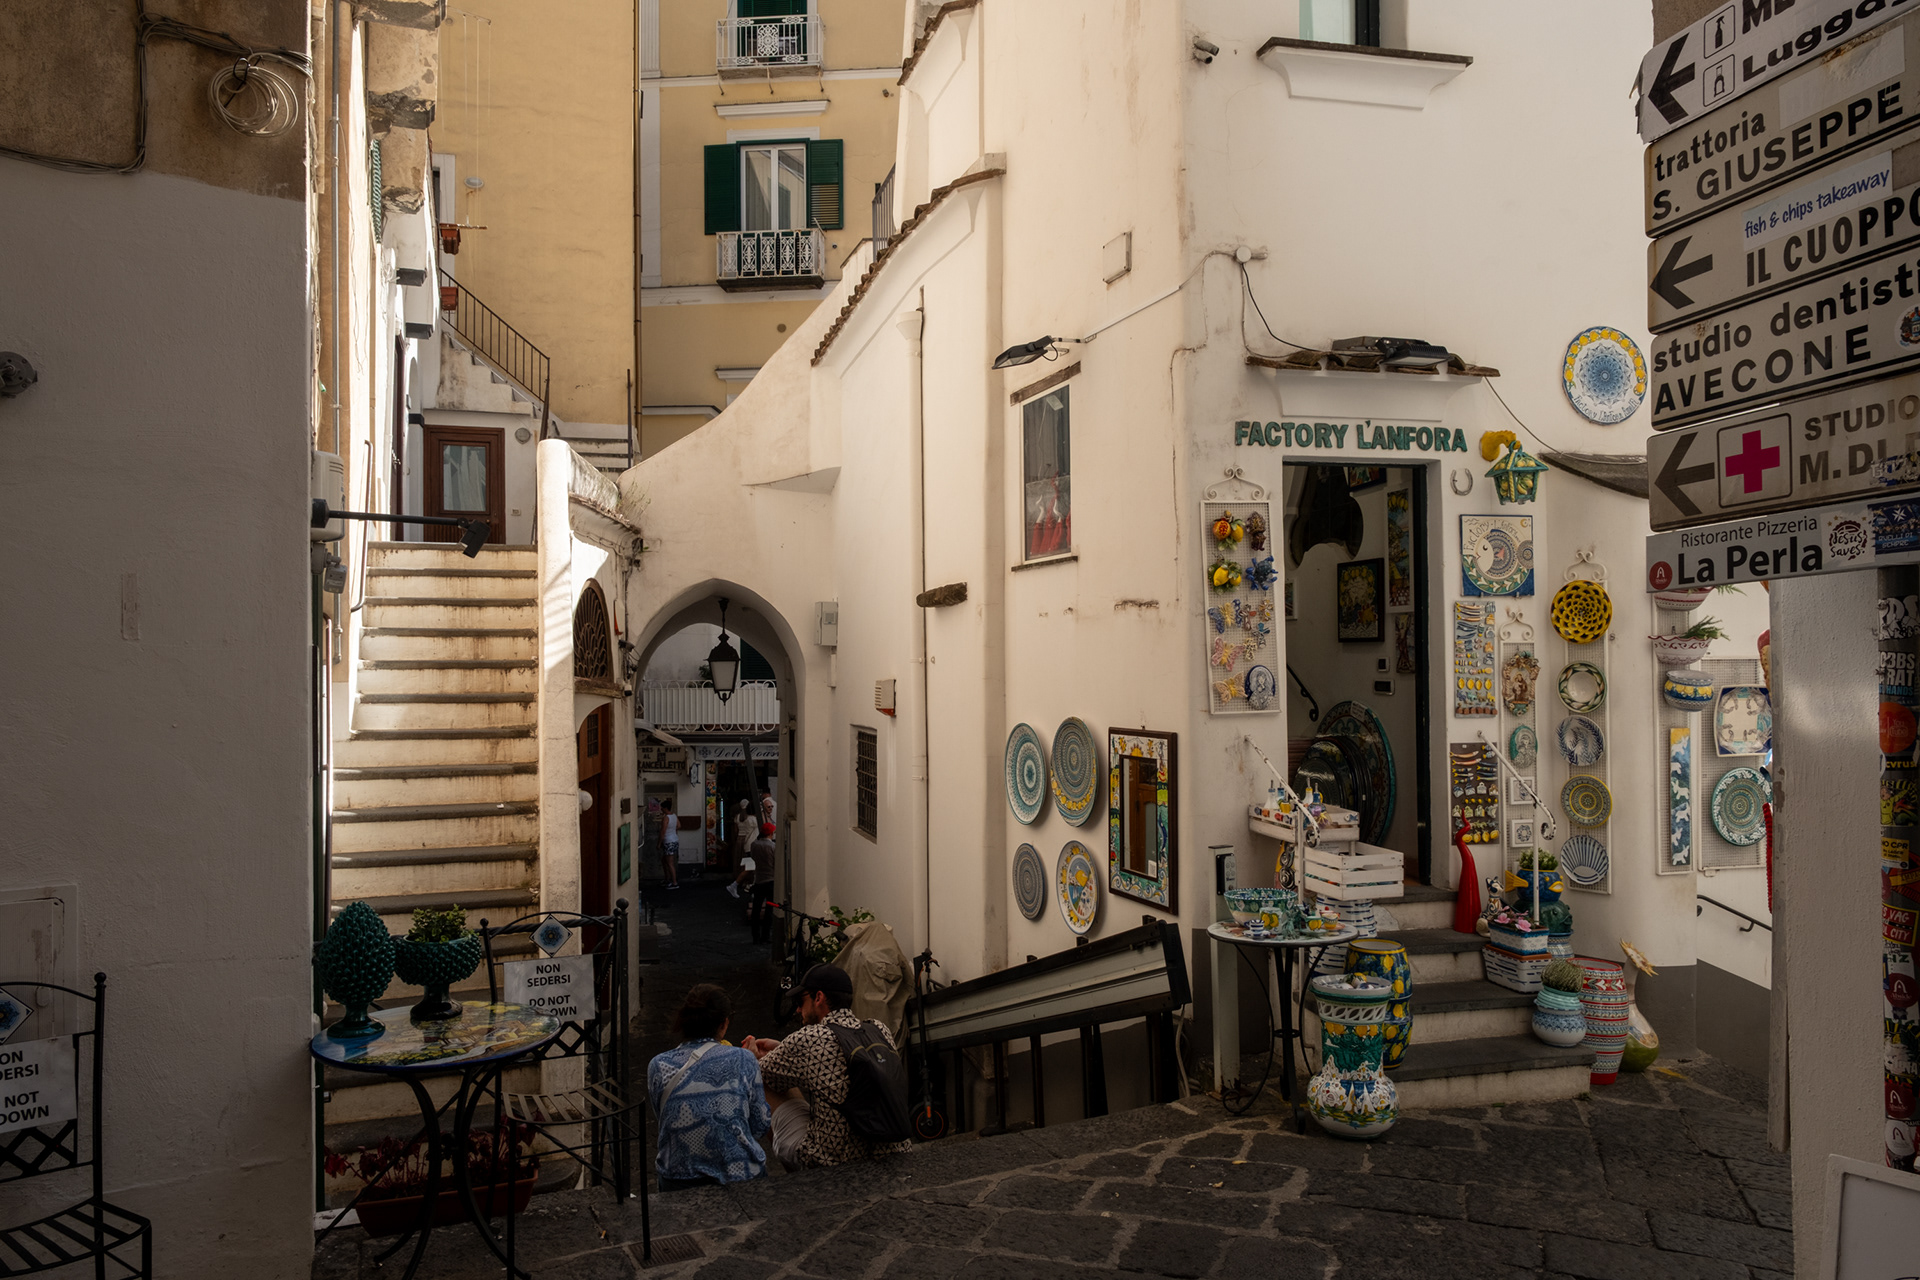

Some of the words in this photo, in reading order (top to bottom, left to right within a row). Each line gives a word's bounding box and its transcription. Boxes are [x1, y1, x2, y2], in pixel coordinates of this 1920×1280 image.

[1743, 0, 1906, 82] Lugga
[1652, 189, 1680, 221] S.
[1696, 81, 1904, 201] GIUSEPPE
[1654, 110, 1766, 182] trattoria
[1744, 216, 1766, 238] fish
[1769, 211, 1779, 228] &
[1782, 200, 1813, 223] chips
[1816, 169, 1890, 209] takeaway
[1747, 247, 1771, 287] IL
[1653, 321, 1752, 373] studio
[1654, 324, 1872, 416] AVECONE
[1235, 420, 1349, 449] FACTORY
[1805, 394, 1920, 441] STUDIO
[1681, 526, 1753, 548] Ristorante
[1757, 516, 1817, 537] Pizzeria
[1678, 553, 1715, 585] La
[1726, 536, 1823, 580] Perla
[527, 974, 571, 987] SEDERSI
[536, 963, 561, 974] NON
[547, 995, 571, 1006] NOT
[4, 1090, 39, 1108] NOT
